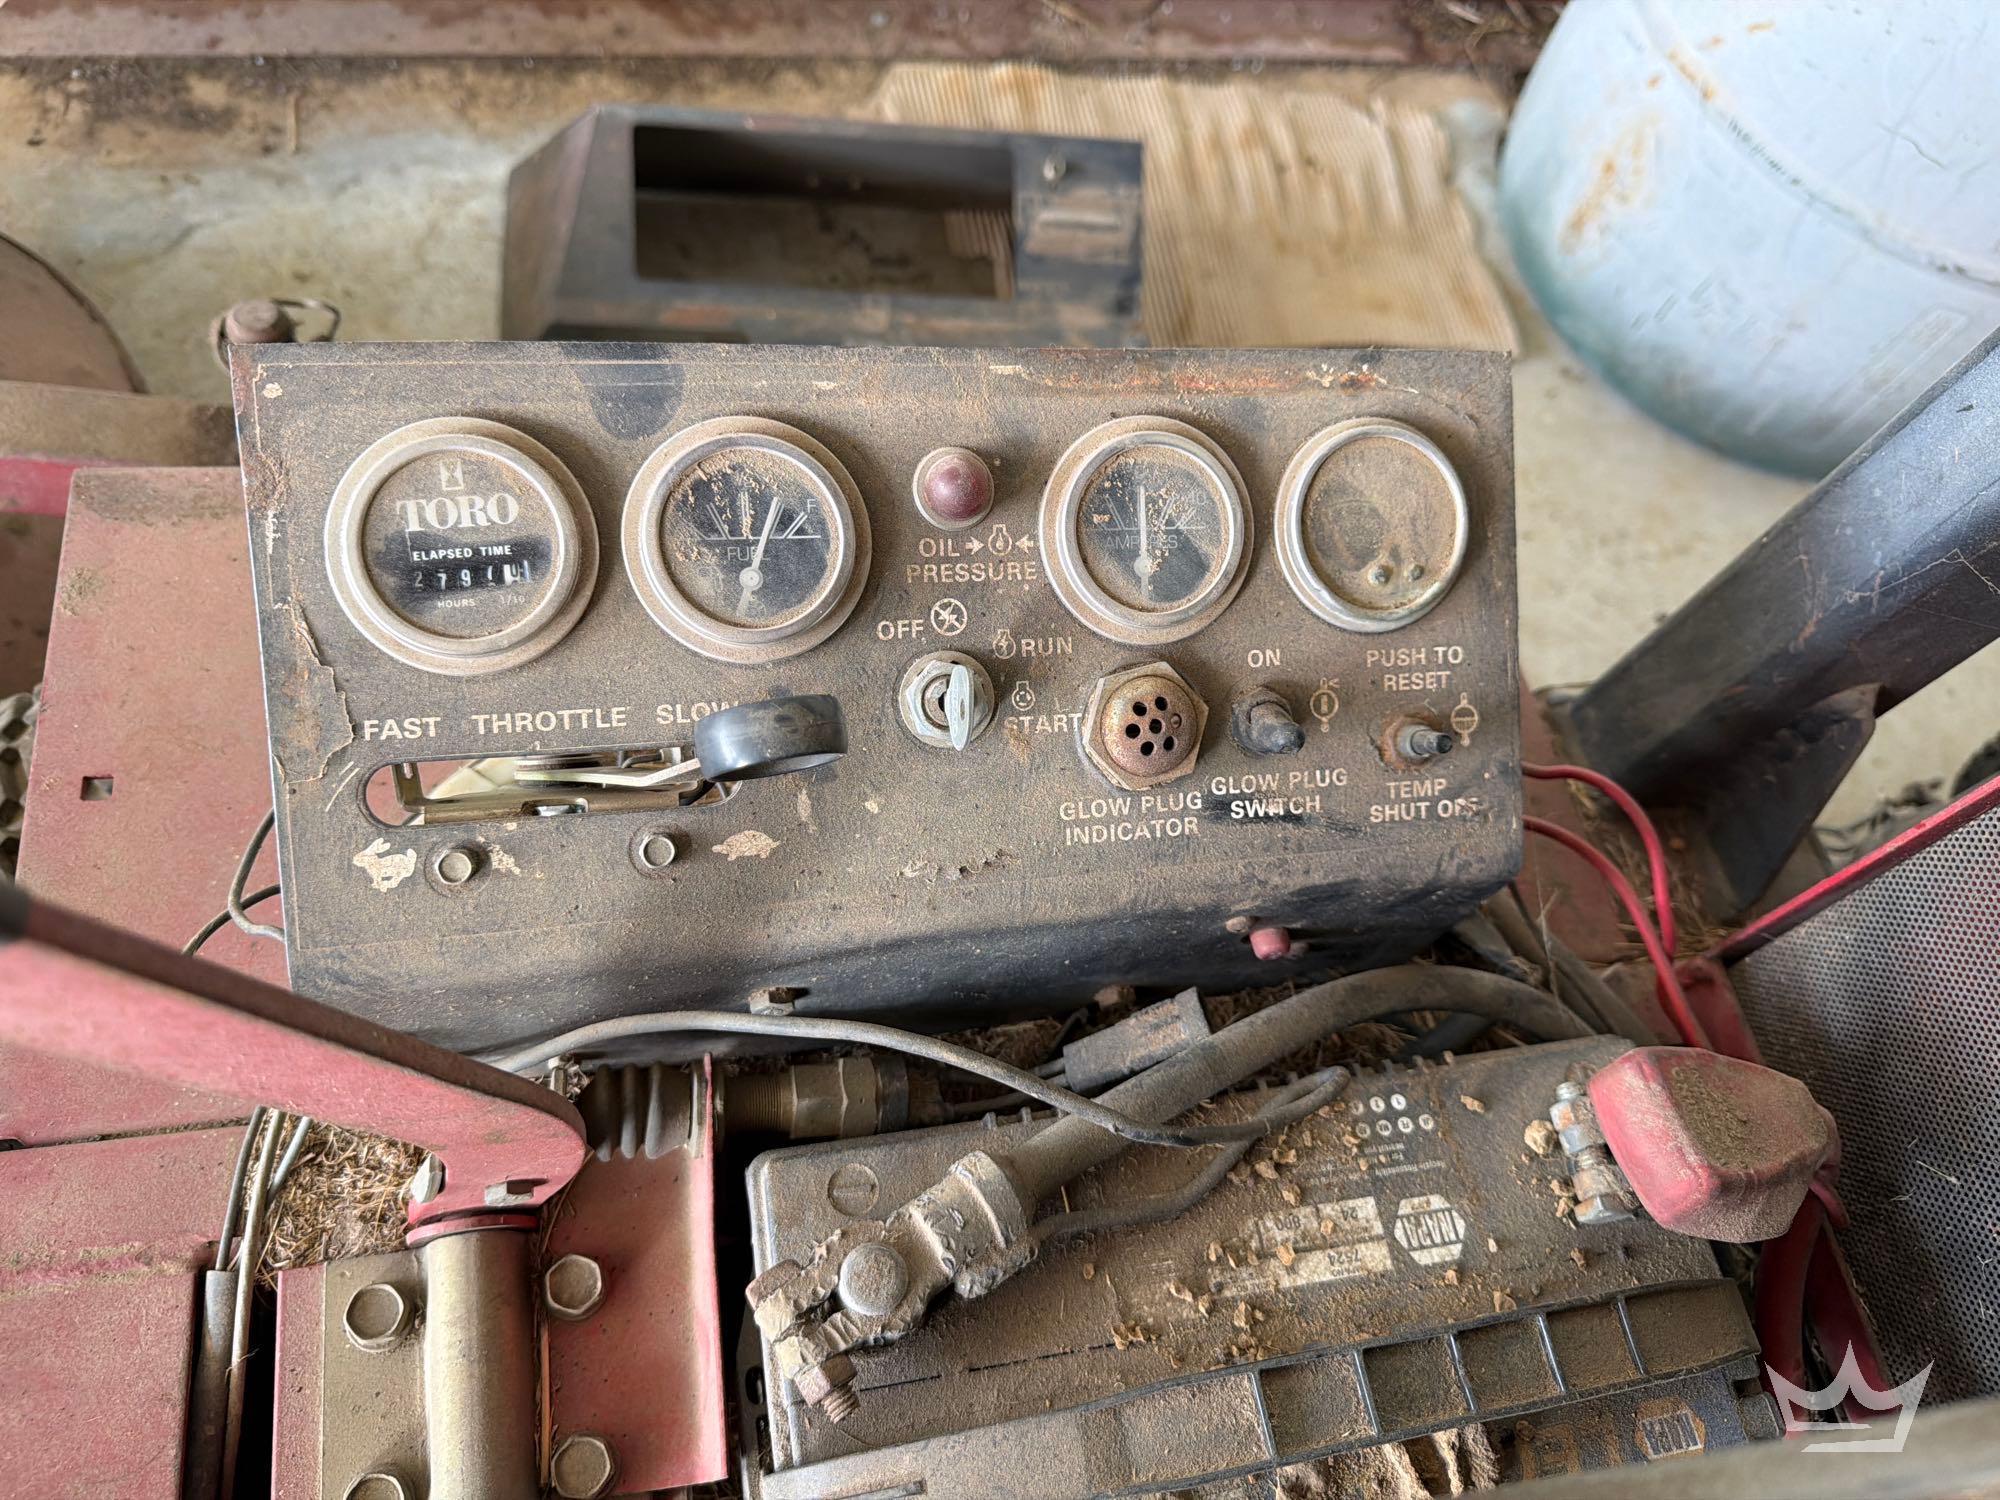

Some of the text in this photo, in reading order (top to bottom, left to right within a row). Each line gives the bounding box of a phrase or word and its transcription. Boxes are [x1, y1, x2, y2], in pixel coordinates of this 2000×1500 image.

[397, 493, 519, 532] TORO
[806, 498, 818, 513] F
[918, 538, 960, 558] OIL
[1105, 534, 1178, 549] AMPRES
[412, 545, 513, 561] ELAPSED TIME
[906, 561, 1038, 583] PRESSURE
[437, 599, 476, 608] HOURS
[876, 619, 924, 641] OFF
[1021, 636, 1073, 657] RUN
[1366, 646, 1463, 668] PUSH TO
[1247, 649, 1281, 668] ON
[1383, 671, 1451, 691] RESET
[364, 716, 441, 742] FAST
[472, 706, 628, 735] THROTTLE
[1004, 713, 1082, 734] START
[1210, 767, 1348, 796] GLOW PLUG
[1385, 778, 1448, 800] TEMP
[1059, 791, 1202, 822] GLOW PLUG
[1230, 795, 1321, 819] SWITCH
[1369, 801, 1431, 823] SHUT
[1065, 818, 1199, 846] INDICATOR
[1274, 1215, 1302, 1231] 800
[1340, 1207, 1358, 1221] 24
[1402, 1210, 1455, 1250] NAPA
[1327, 1248, 1361, 1266] 7524
